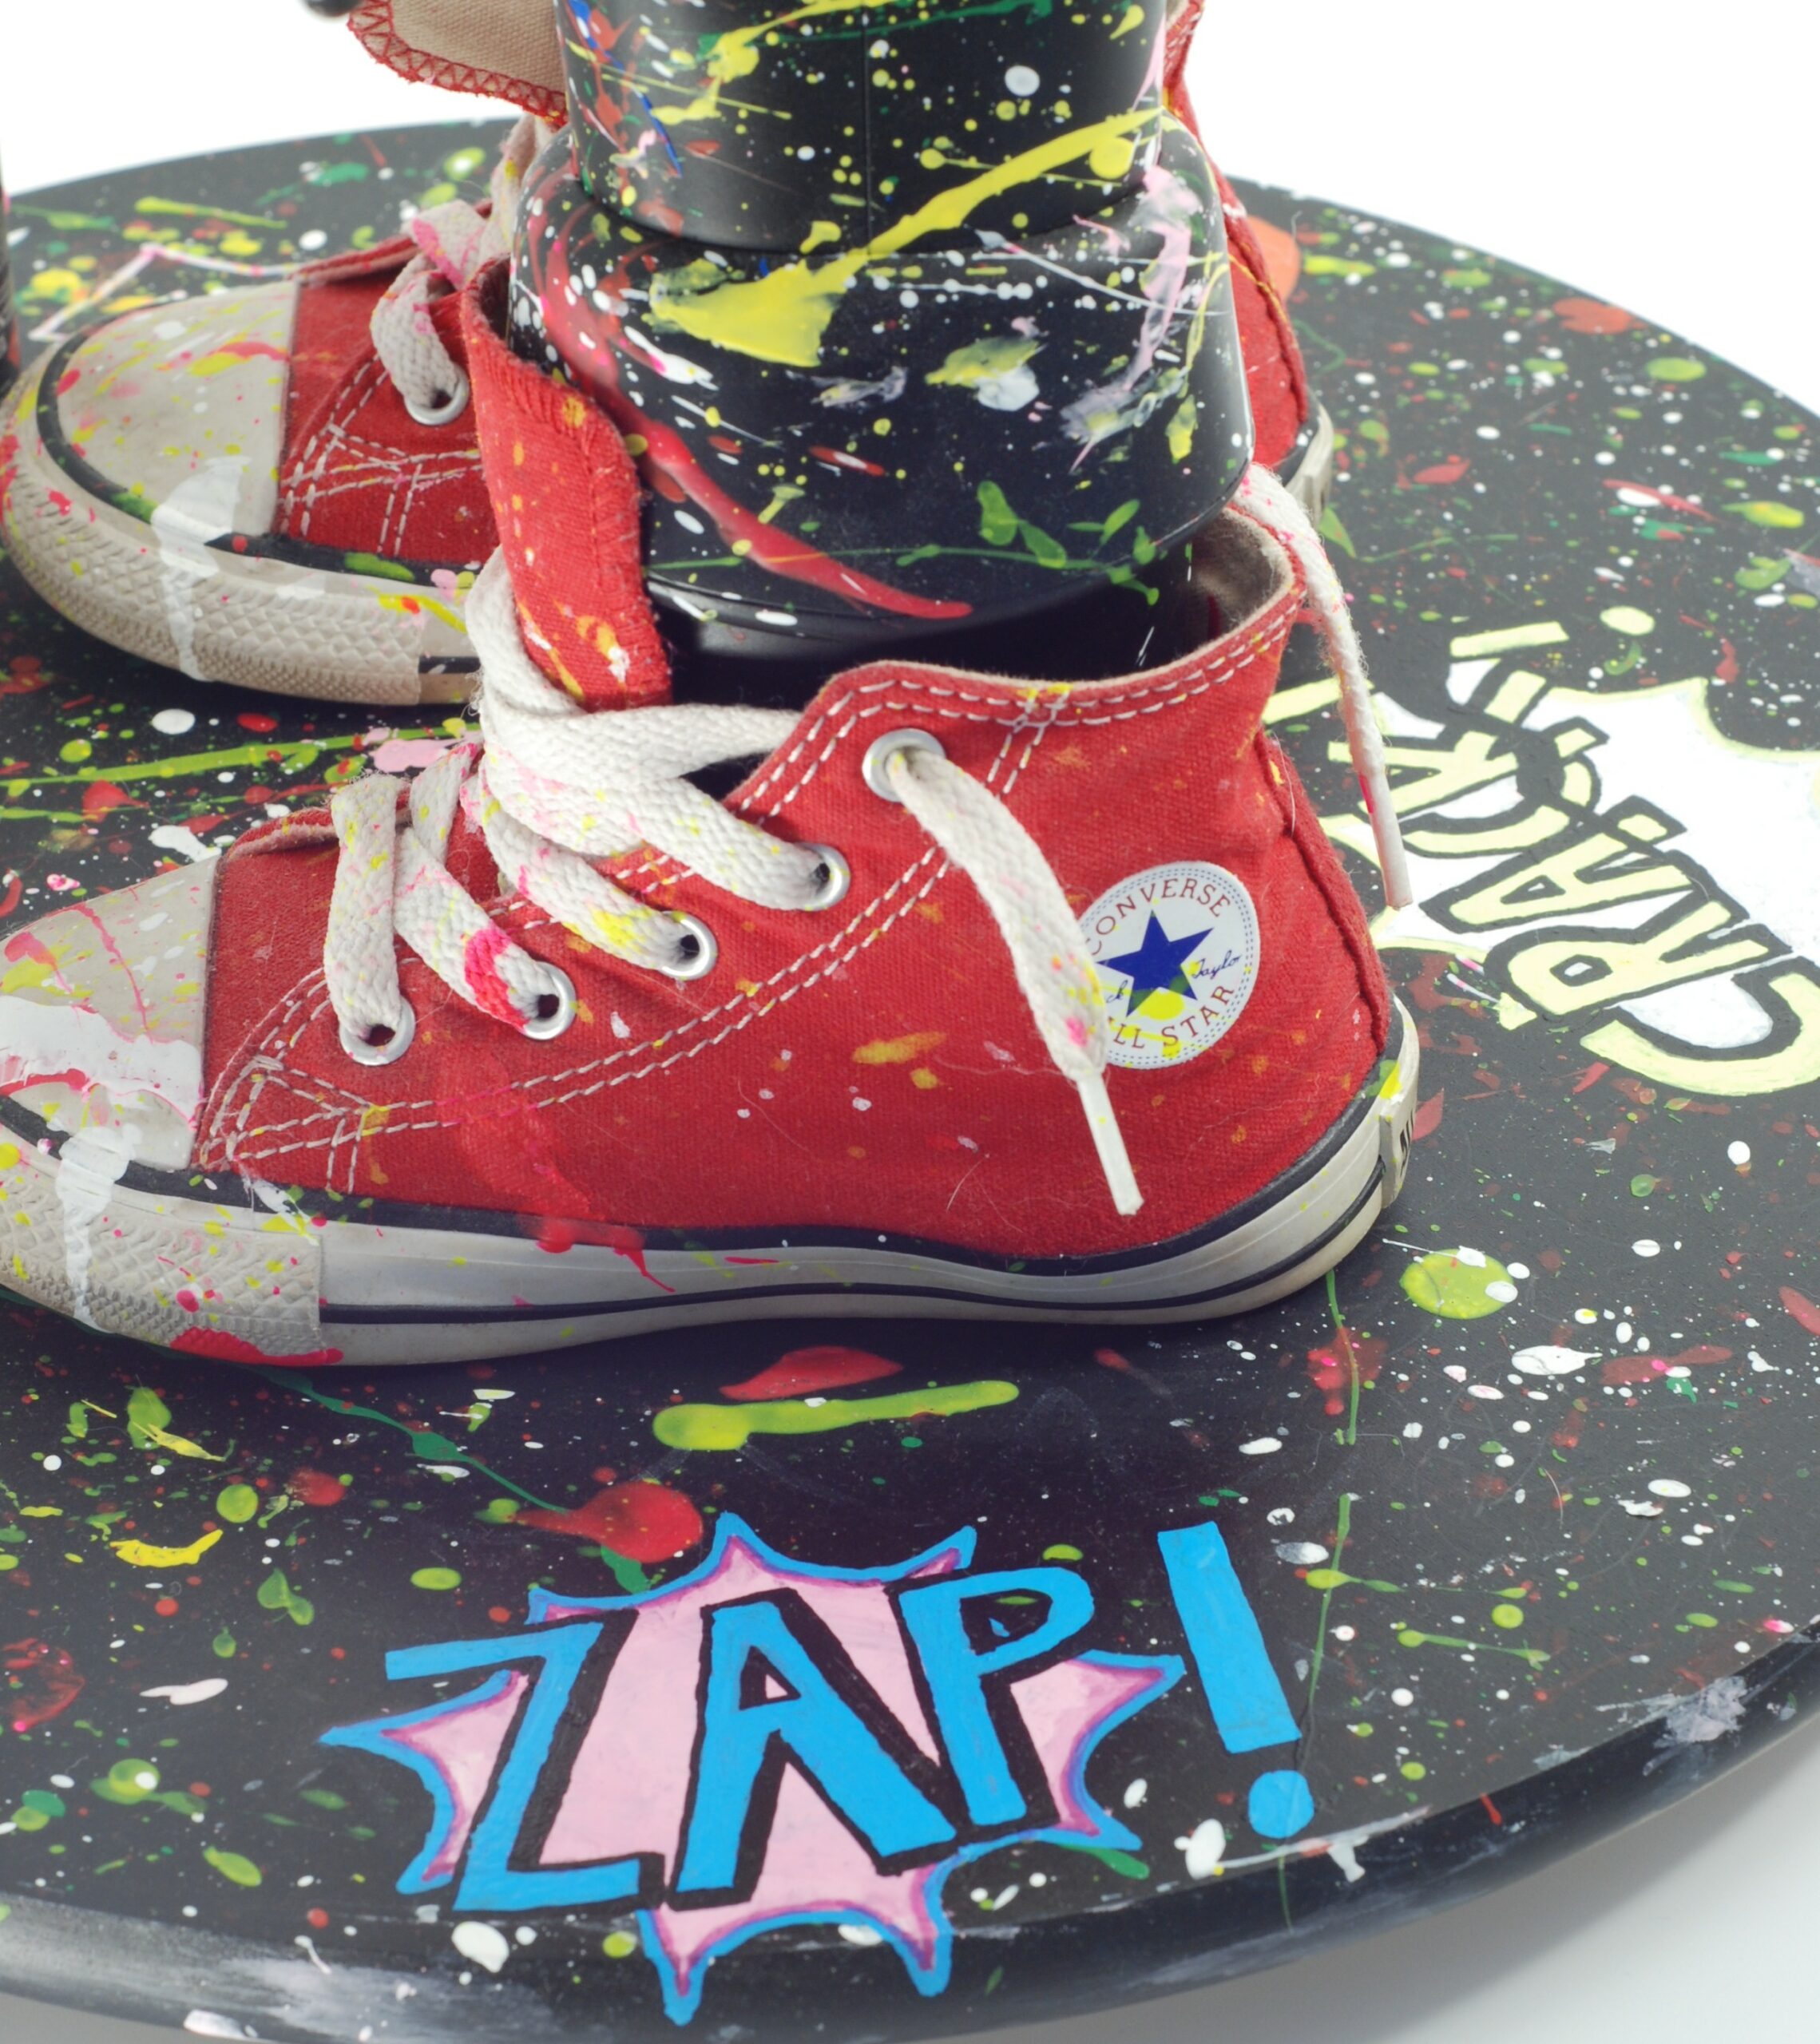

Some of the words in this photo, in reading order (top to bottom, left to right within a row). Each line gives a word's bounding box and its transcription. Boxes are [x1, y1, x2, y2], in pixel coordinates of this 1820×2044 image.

[1108, 1016, 1145, 1048] LL
[1161, 985, 1235, 1048] STAR
[385, 1521, 1314, 1911] ZAP!
